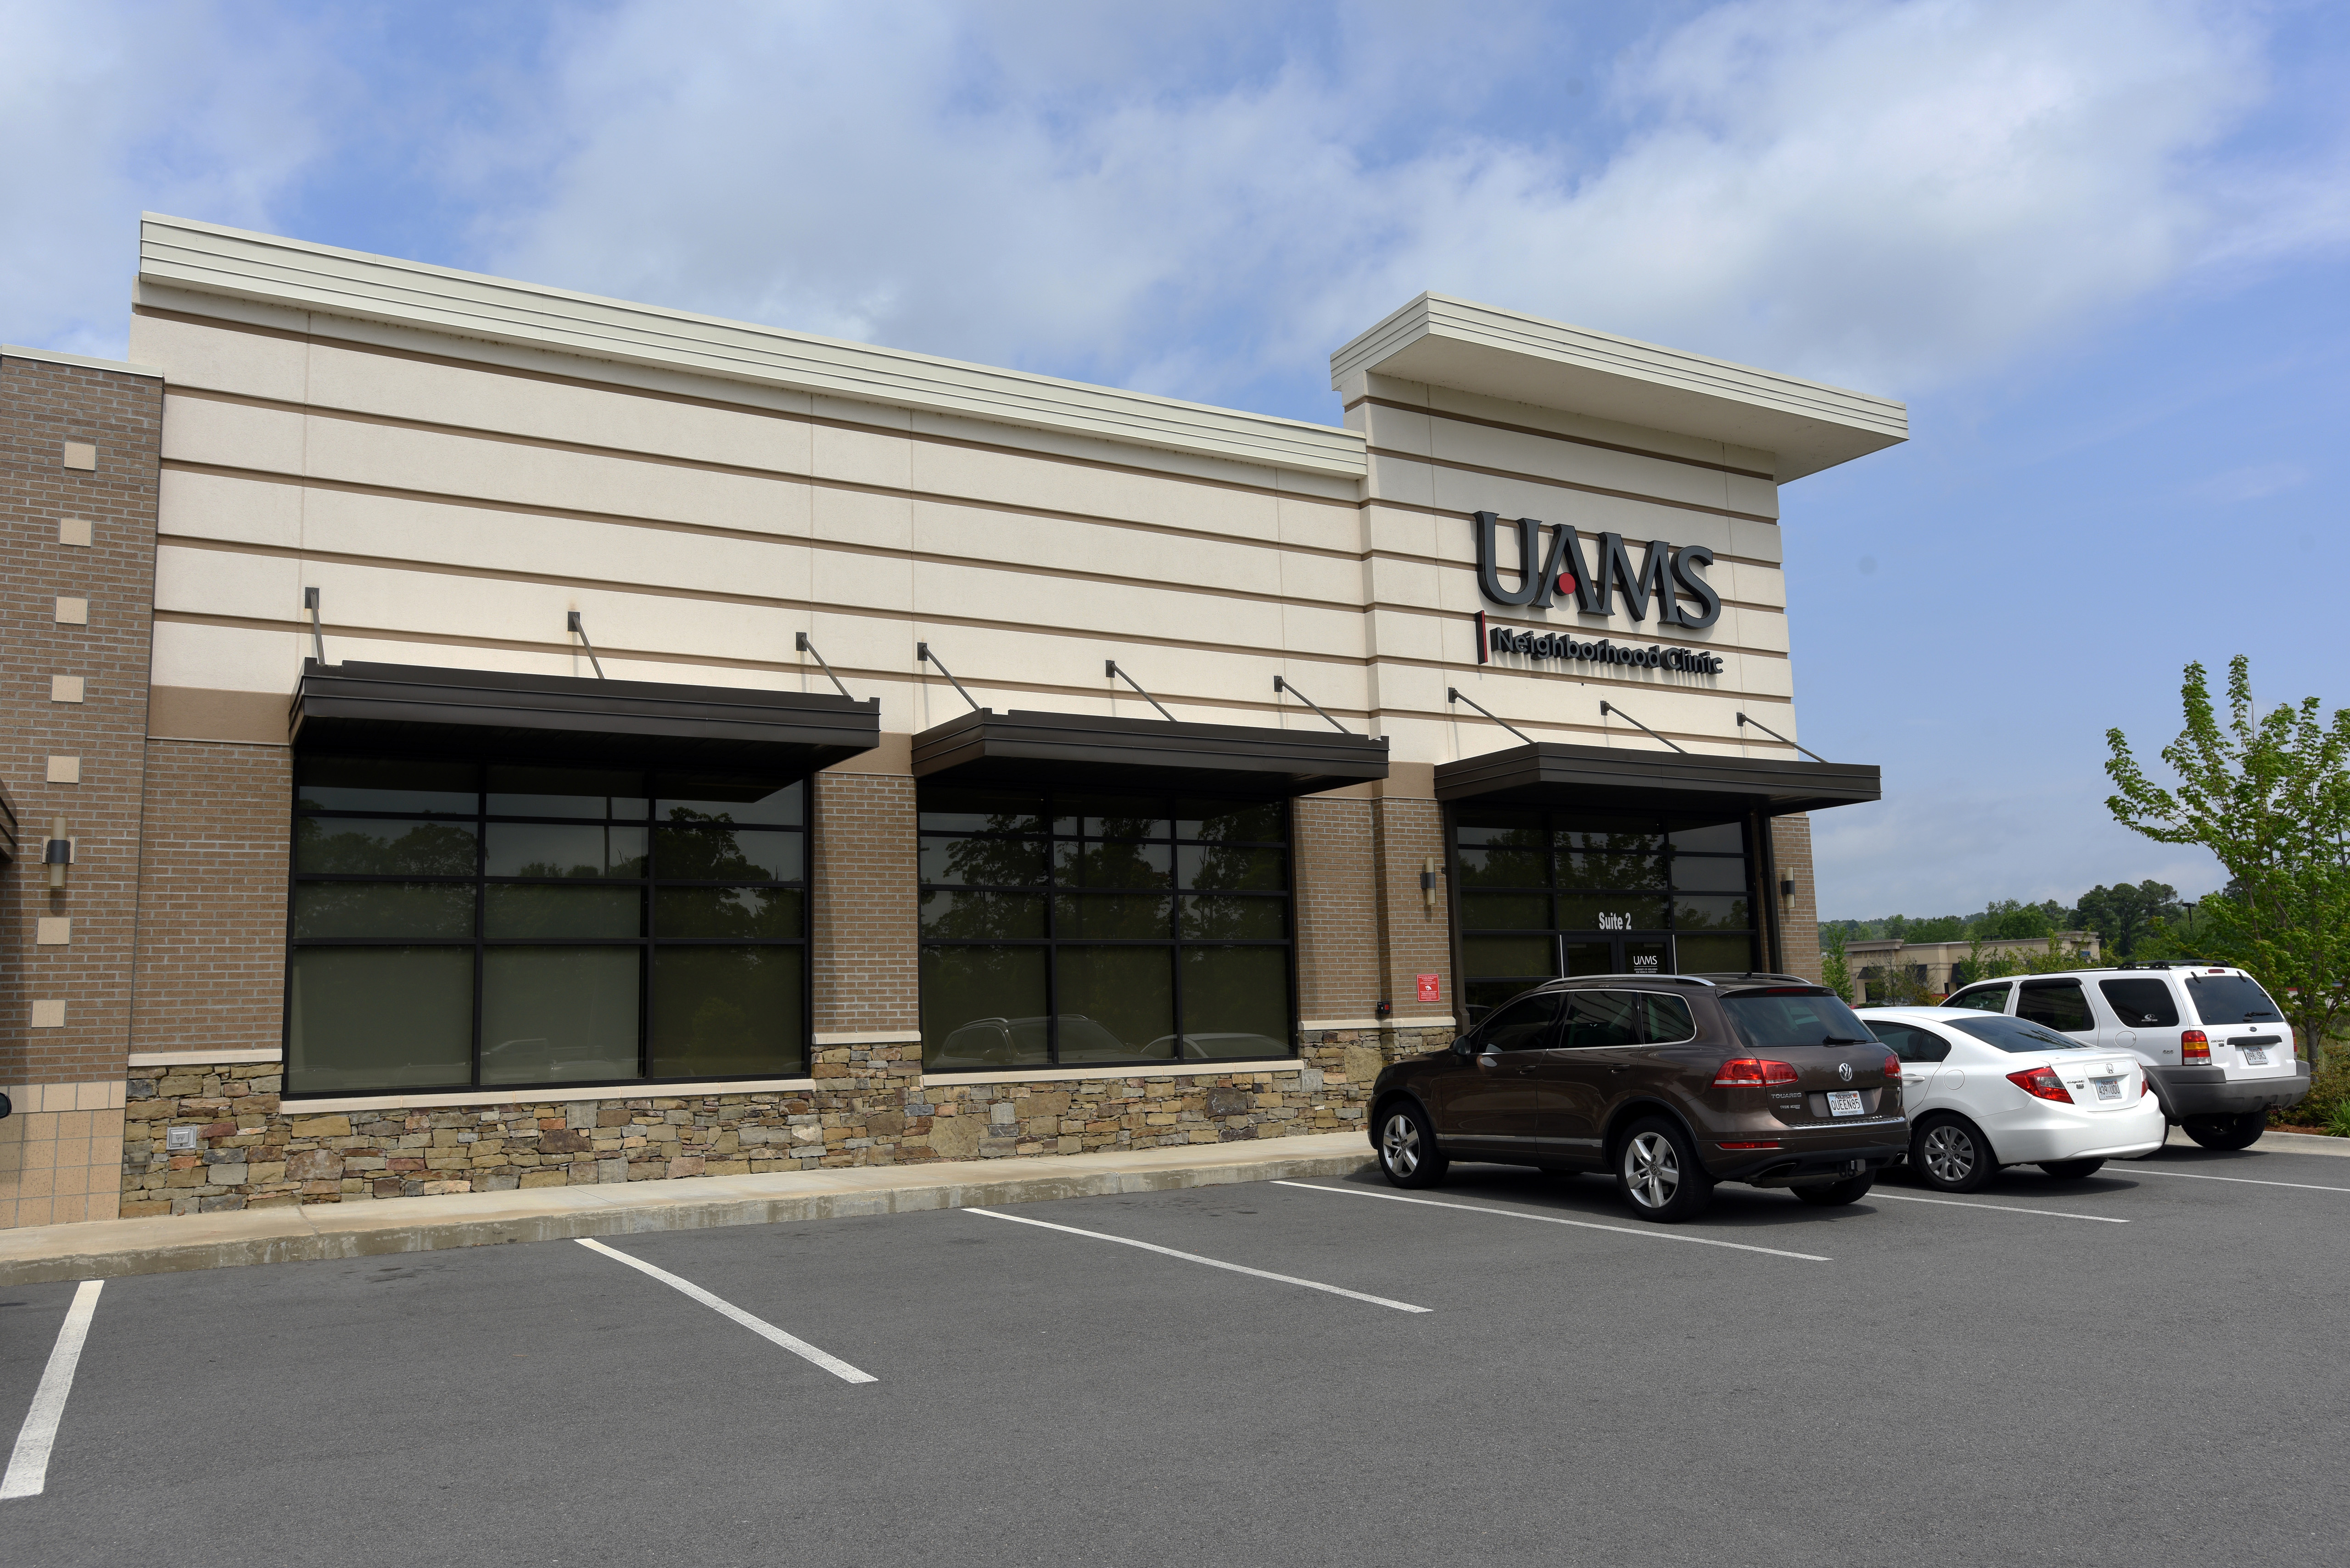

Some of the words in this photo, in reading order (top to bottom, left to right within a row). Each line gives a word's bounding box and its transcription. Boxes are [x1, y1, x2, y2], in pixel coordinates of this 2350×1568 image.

[1472, 510, 1721, 630] UAMS
[1490, 627, 1661, 668] Neighborhood
[1660, 647, 1724, 675] Clinic
[1599, 912, 1623, 930] Suite
[1625, 912, 1632, 930] 2
[1633, 955, 1657, 965] UAMS
[2247, 1052, 2256, 1060] 098
[2256, 1051, 2266, 1060] SRS
[2099, 1085, 2108, 1095] 439
[1831, 1099, 1860, 1110] QUEEN85
